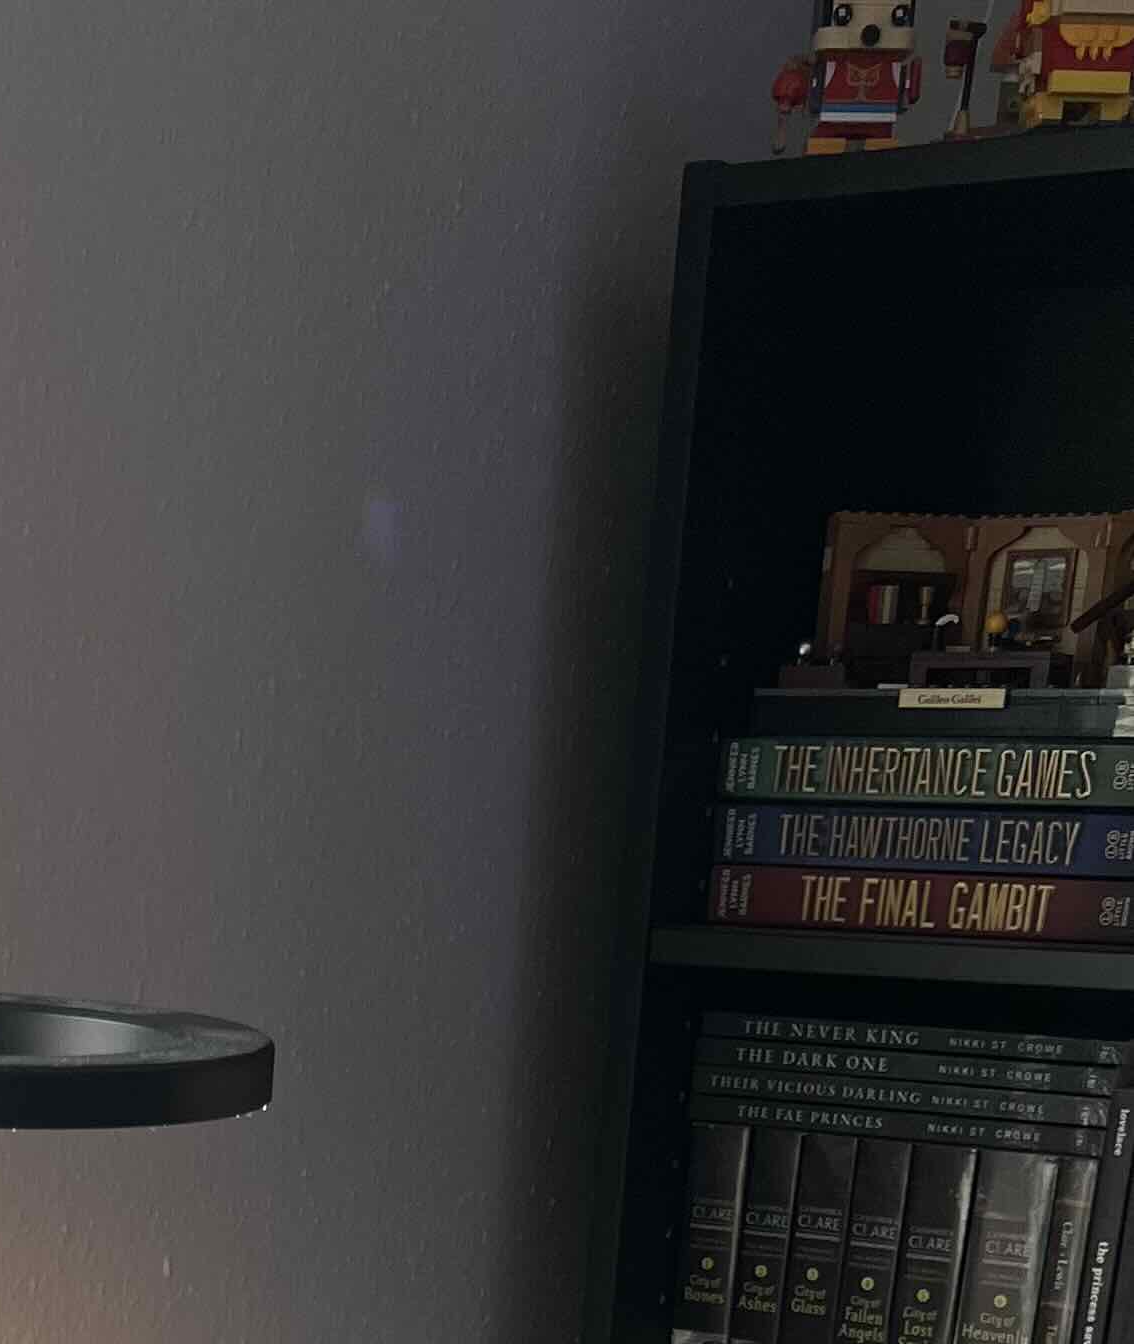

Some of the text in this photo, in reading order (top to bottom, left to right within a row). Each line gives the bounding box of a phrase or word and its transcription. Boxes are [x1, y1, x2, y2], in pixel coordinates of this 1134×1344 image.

[773, 745, 822, 793] THE
[824, 745, 993, 796] INHERITANCE
[995, 749, 1097, 800] GAMES
[779, 814, 824, 856] THE
[828, 815, 975, 862] HAWTHORNE
[979, 820, 1081, 866] LEGACY
[801, 875, 851, 924] THE
[856, 877, 935, 928] FINAL
[947, 881, 1057, 933] GAMBIT
[744, 1019, 921, 1047] THE NEVER KING
[736, 1047, 890, 1073] THE DARK ONE
[709, 1073, 923, 1105] THEIR VICIOUS DARLING
[738, 1104, 883, 1130] THE FAE PRINCES
[1095, 1240, 1110, 1264] the
[791, 1298, 827, 1316] Glass
[1087, 1267, 1104, 1322] princess
[844, 1306, 883, 1327] Fallen
[837, 1323, 883, 1344] Angels
[904, 1322, 934, 1338] Lost
